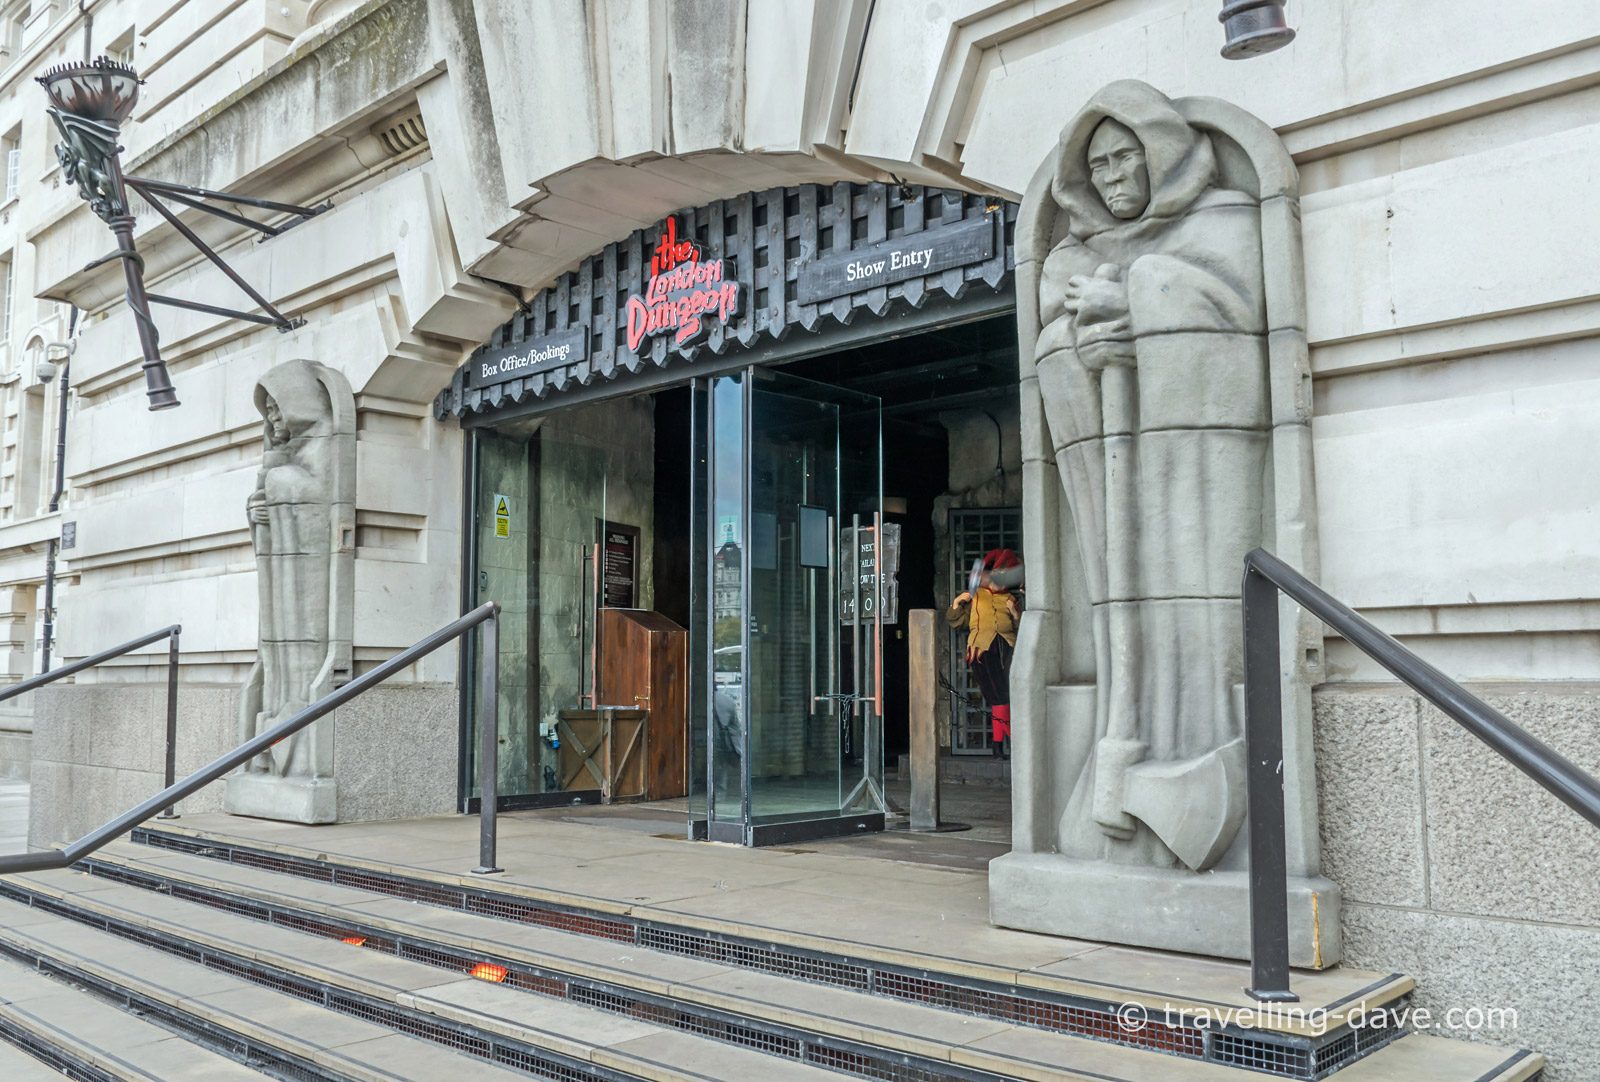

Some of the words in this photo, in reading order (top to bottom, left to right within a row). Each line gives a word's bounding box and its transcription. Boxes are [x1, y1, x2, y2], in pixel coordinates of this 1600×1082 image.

[655, 216, 693, 271] the
[846, 261, 886, 281] Show
[890, 248, 934, 269] Entry
[646, 249, 722, 307] London
[627, 283, 737, 351] Dungeon
[481, 363, 498, 378] Box
[499, 343, 570, 373] Office/Bookings
[870, 573, 886, 584] TE
